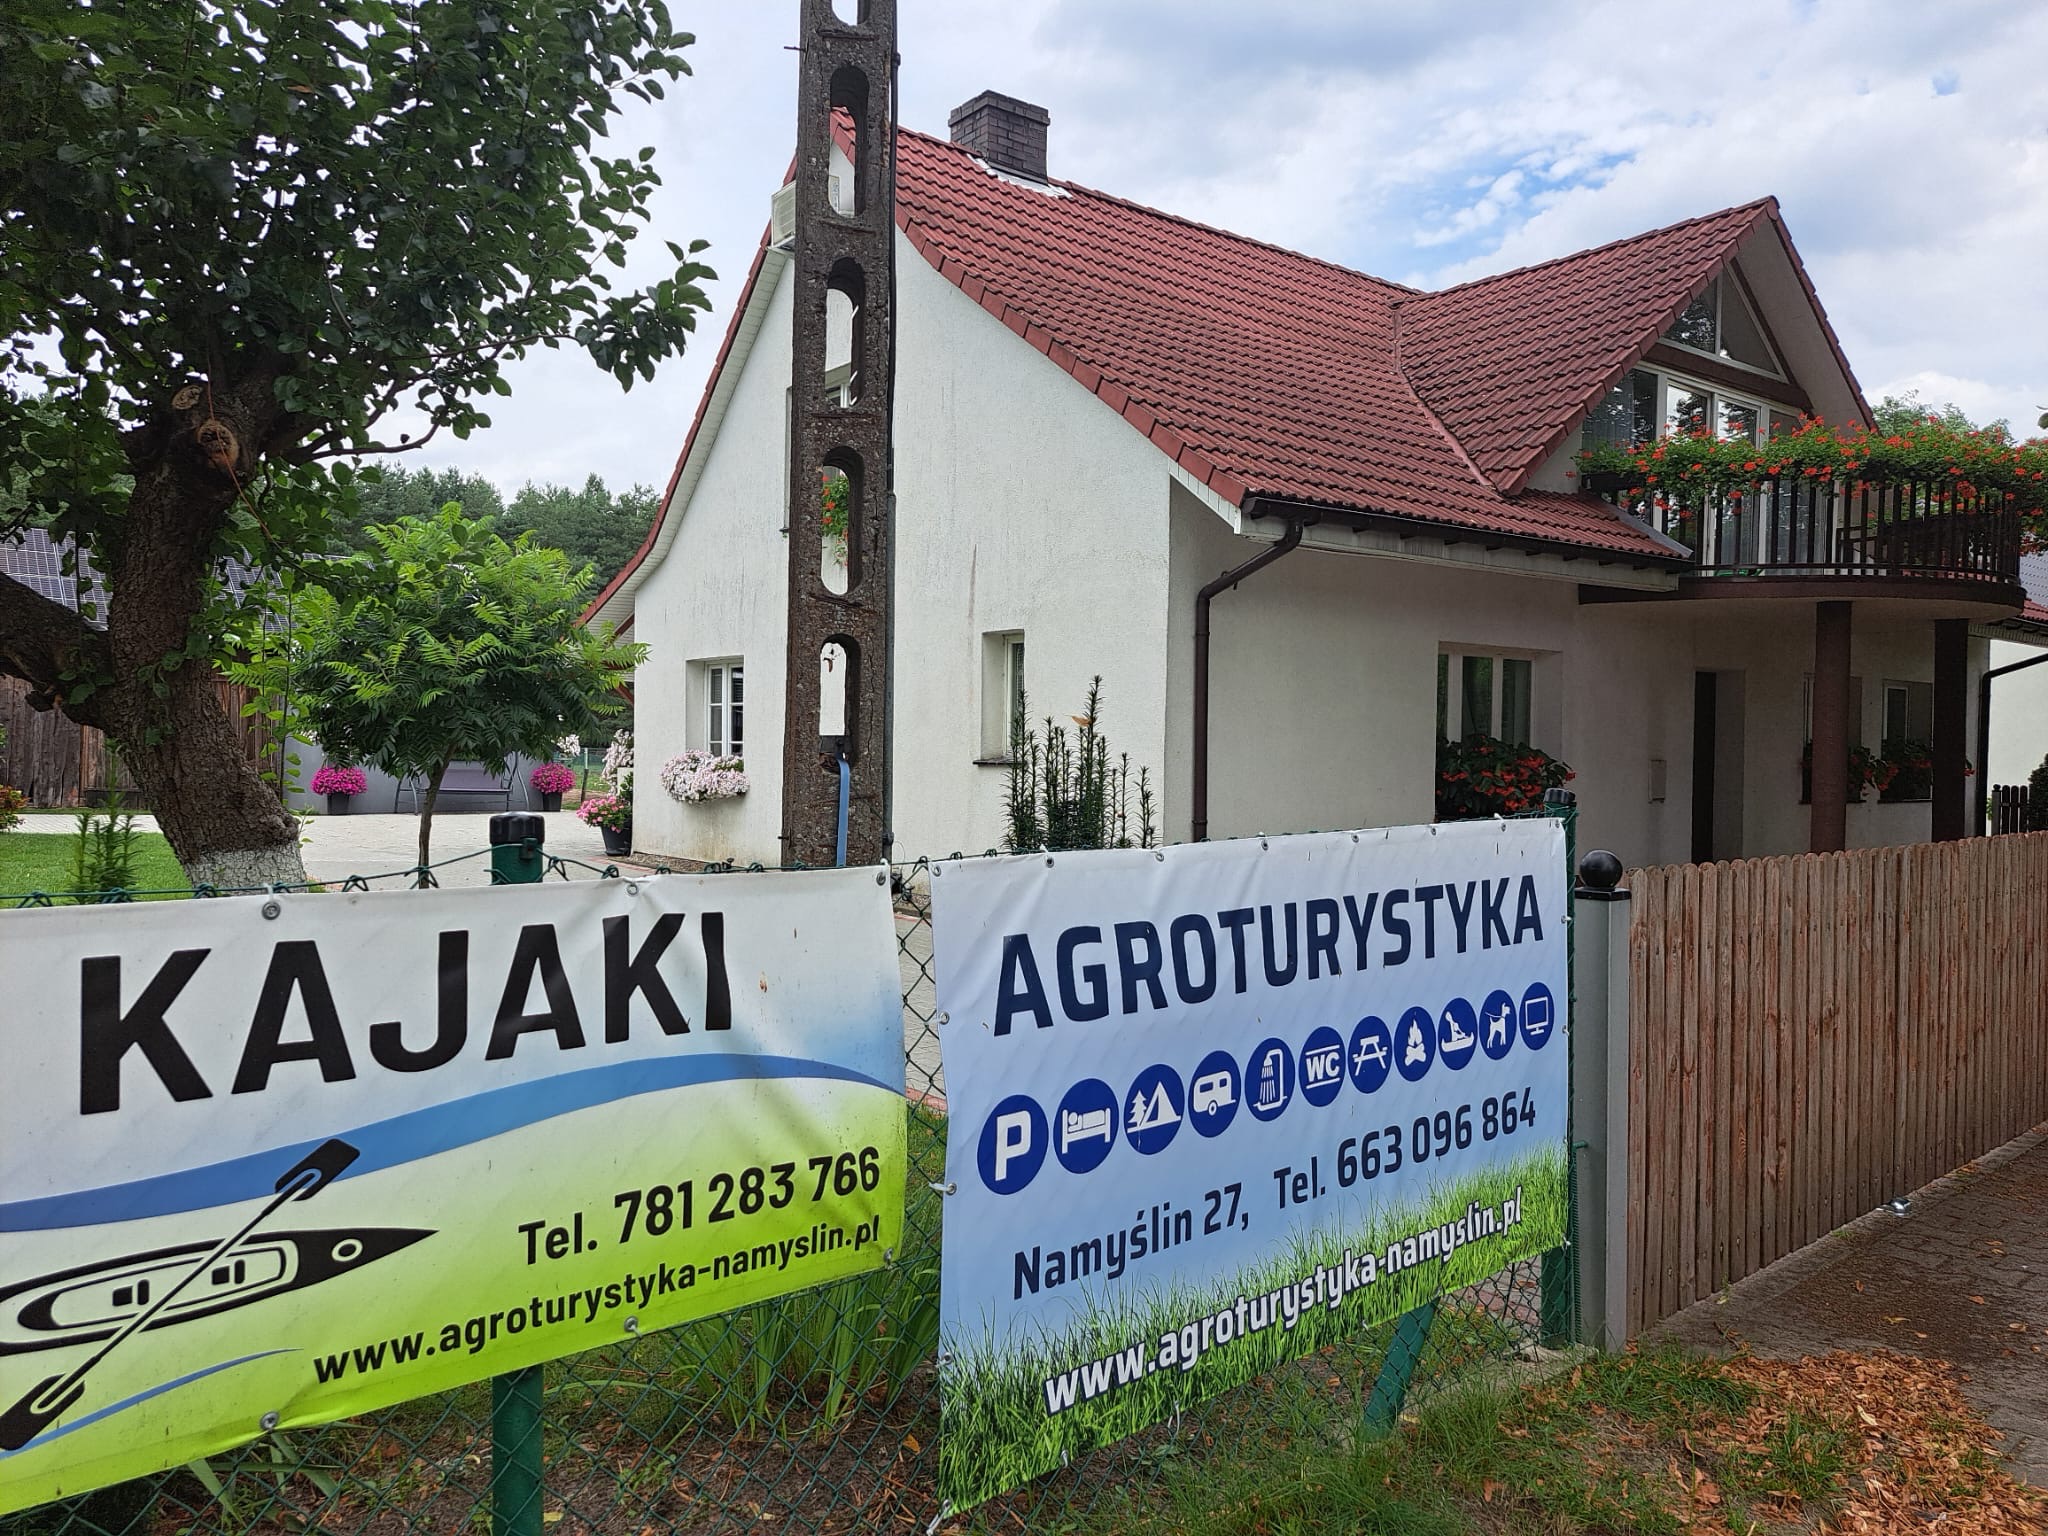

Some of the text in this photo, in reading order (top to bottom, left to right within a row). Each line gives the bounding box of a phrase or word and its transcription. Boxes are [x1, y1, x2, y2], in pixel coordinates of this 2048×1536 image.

[79, 911, 733, 1115] KAJAKI
[993, 875, 1544, 1036] AGROTURYSTYKA
[995, 1111, 1032, 1181] P
[1306, 1049, 1341, 1083] WC
[518, 1146, 880, 1265] Tel. 781 283 766
[1013, 1087, 1537, 1299] Namyślin 27, Tel. 663 096 864
[314, 1214, 881, 1386] www.agroturystyka-namyslin.pl
[1043, 1186, 1523, 1417] www.agroturystyka-namyslin.pl
